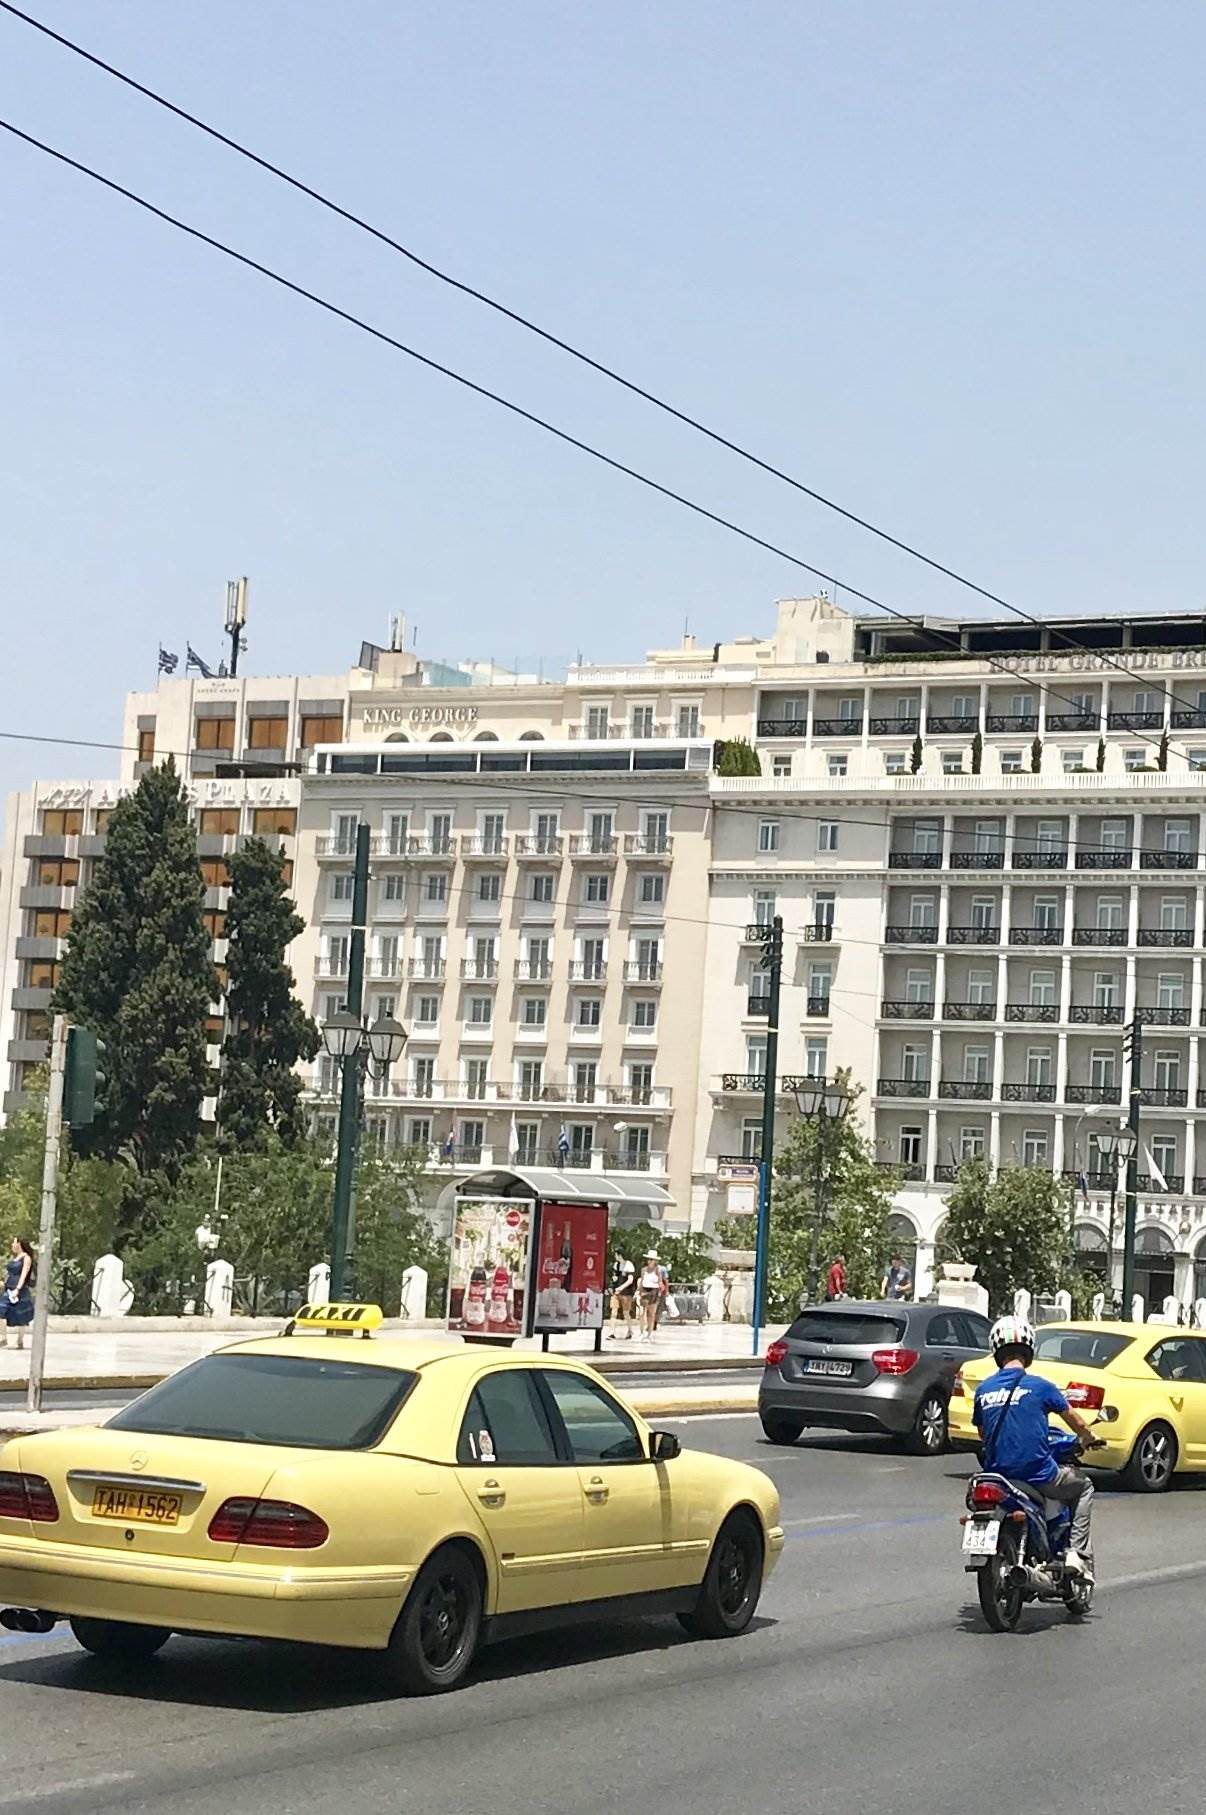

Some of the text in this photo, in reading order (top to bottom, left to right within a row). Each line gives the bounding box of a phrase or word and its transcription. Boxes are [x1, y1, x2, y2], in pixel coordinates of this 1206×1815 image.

[990, 655, 1057, 673] HOTEL
[1068, 652, 1158, 671] GRANDE
[363, 706, 479, 724] KING GEORGE
[205, 782, 290, 801] PLAZA
[303, 1305, 363, 1321] TAXI
[137, 1494, 179, 1520] 1562
